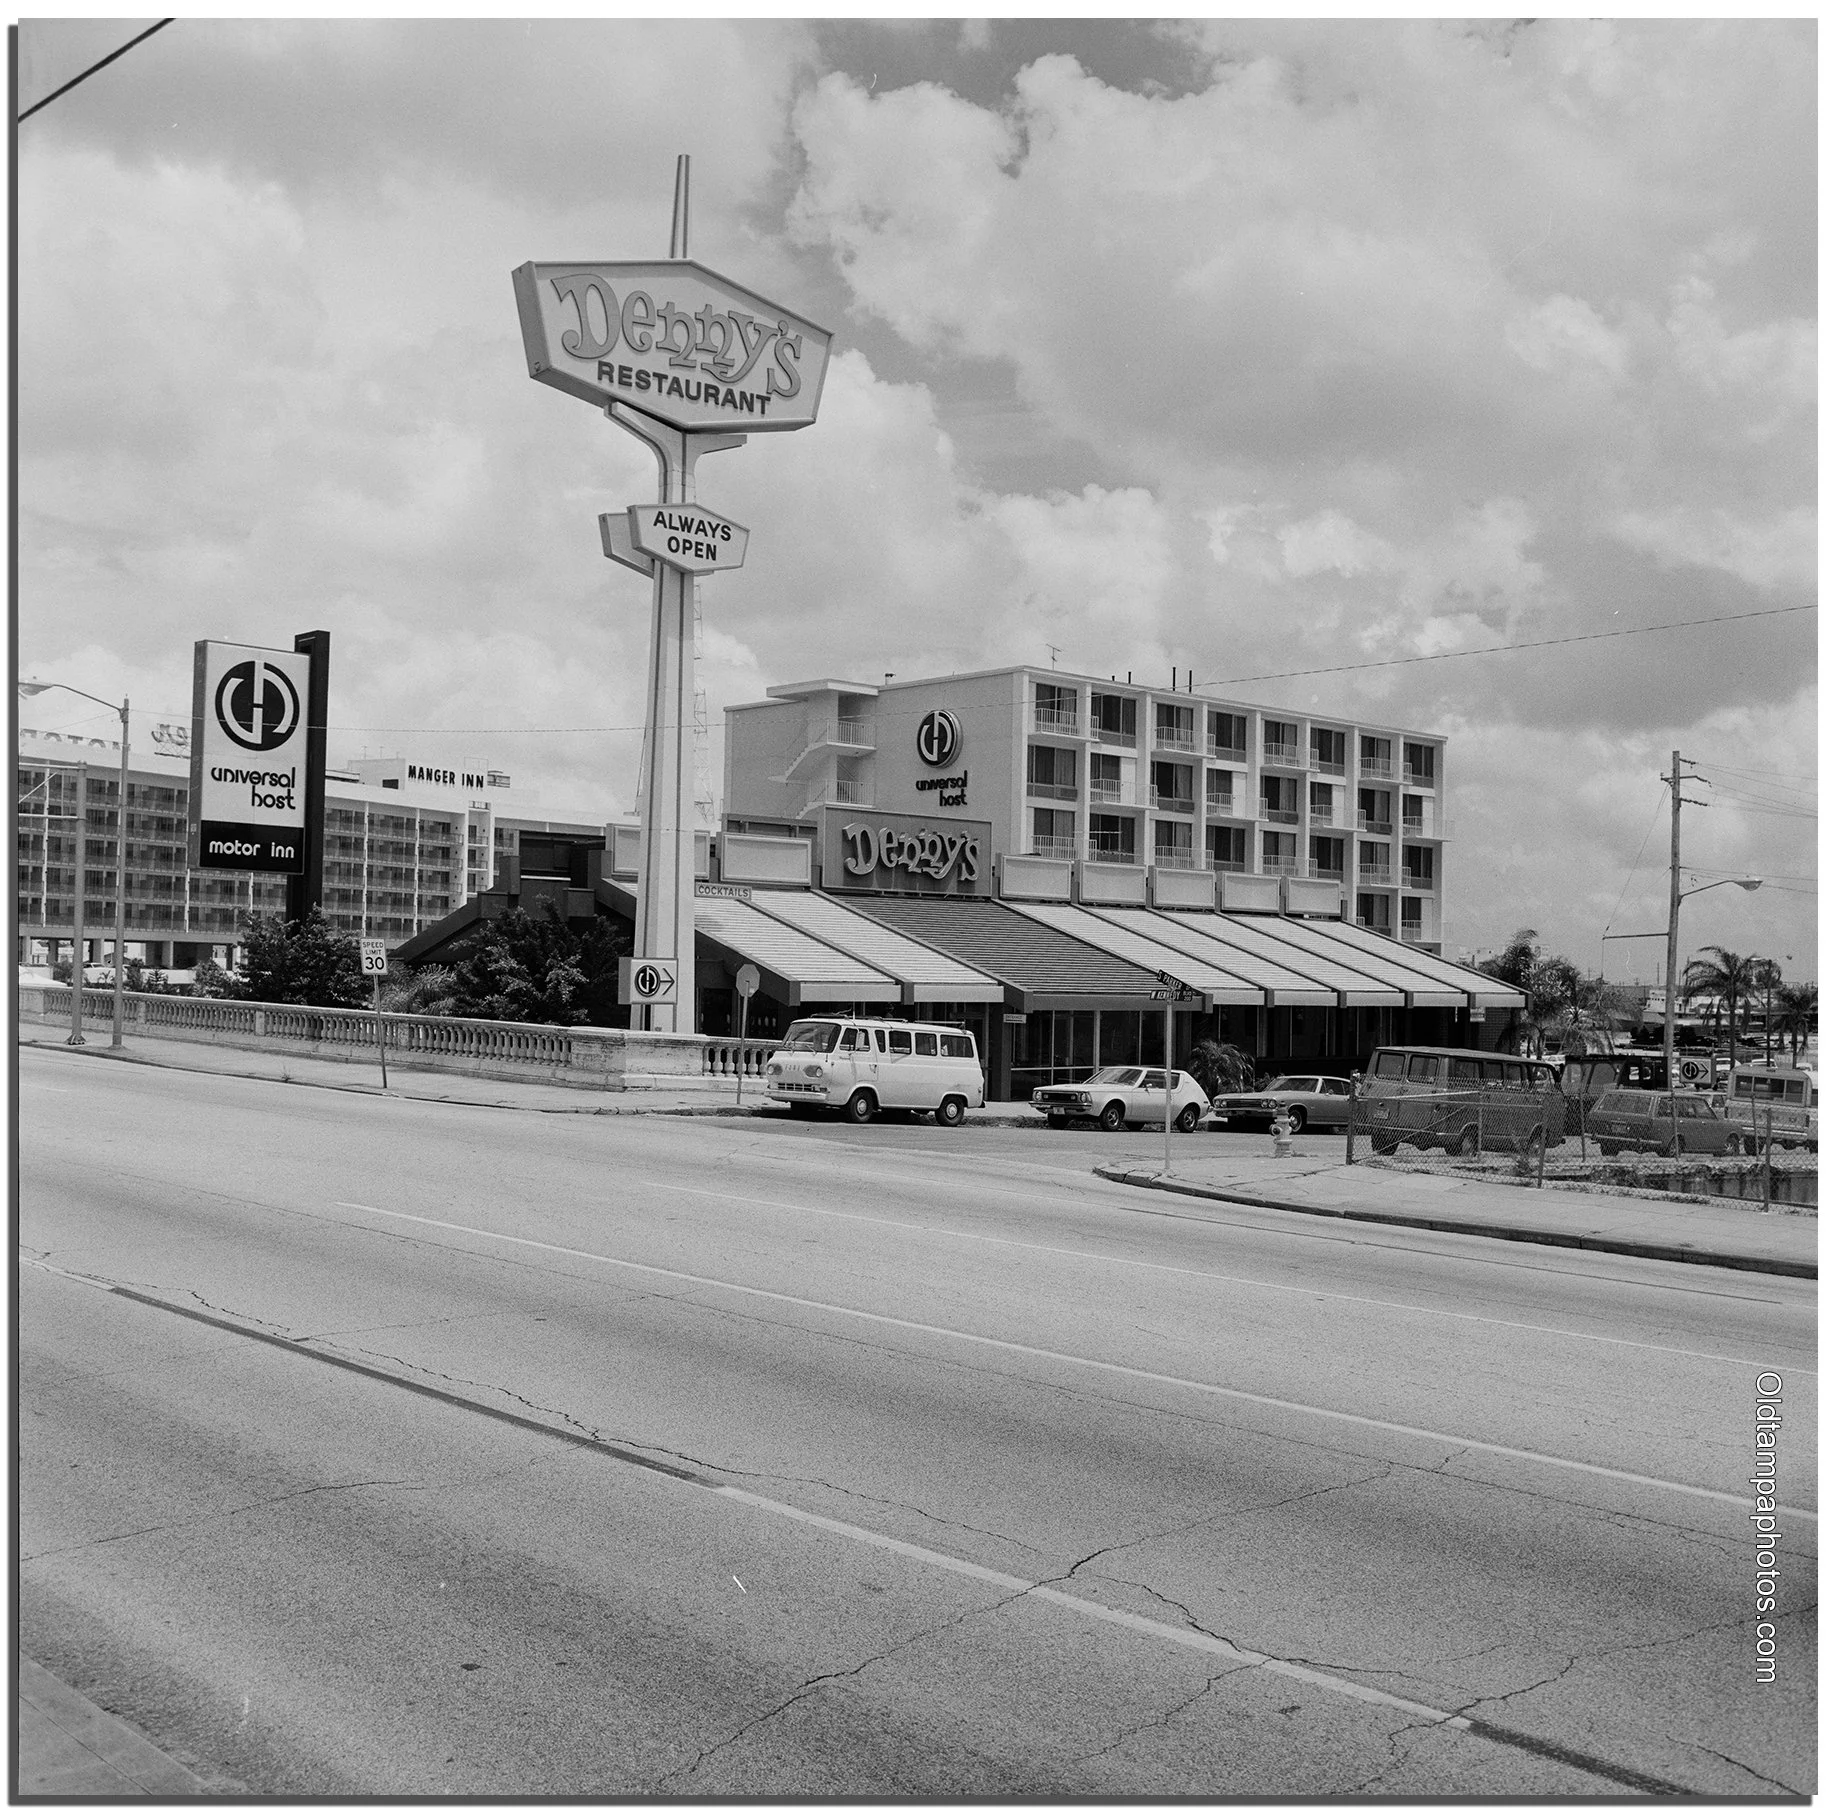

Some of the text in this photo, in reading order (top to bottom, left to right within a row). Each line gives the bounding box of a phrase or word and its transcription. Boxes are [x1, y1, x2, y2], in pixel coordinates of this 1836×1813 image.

[550, 273, 803, 398] Denny's
[597, 360, 771, 415] RESTAURANT
[653, 511, 732, 541] ALWAYS
[667, 536, 717, 561] OPEN
[211, 767, 296, 788] universal
[408, 764, 484, 788] MANGER INN
[915, 770, 967, 791] universal
[251, 785, 296, 810] host
[939, 788, 967, 807] host
[209, 840, 294, 858] motor inn
[842, 822, 981, 882] Denny's
[698, 885, 749, 897] COCKTAILS
[362, 941, 383, 949] SPEED
[365, 956, 385, 970] 30
